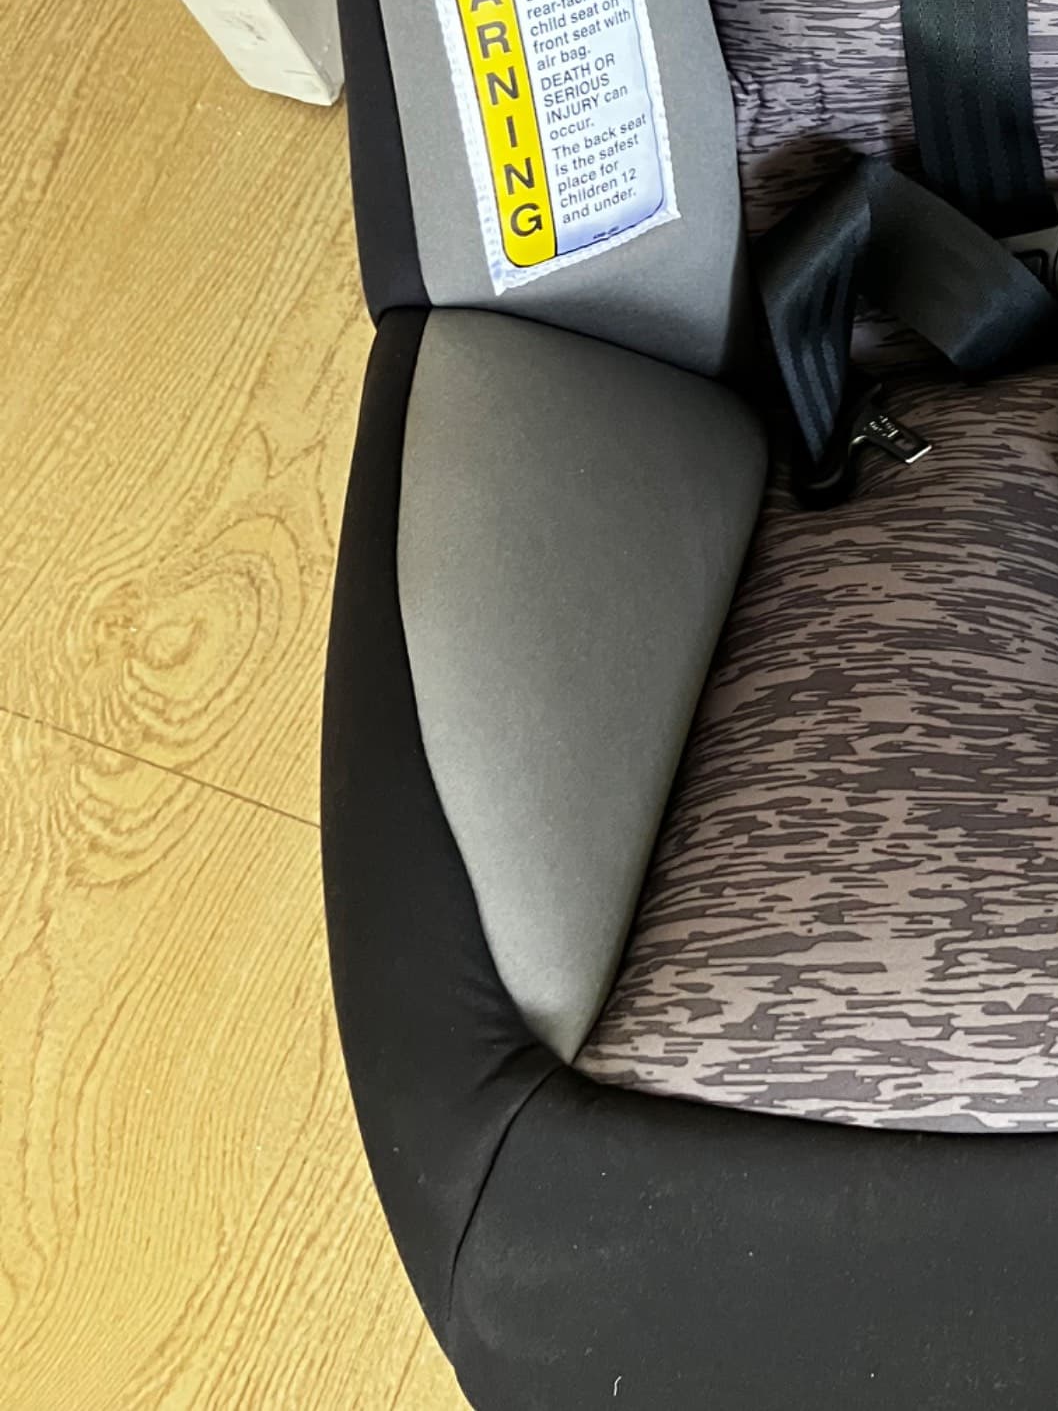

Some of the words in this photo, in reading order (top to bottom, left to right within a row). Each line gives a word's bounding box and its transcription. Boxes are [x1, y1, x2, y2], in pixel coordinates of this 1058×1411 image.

[530, 13, 567, 37] child
[570, 2, 599, 23] seat
[533, 31, 569, 54] front
[572, 20, 602, 41] seat
[604, 8, 631, 28] with
[537, 54, 556, 71] air
[560, 45, 591, 63] bag.
[541, 62, 591, 91] DEATH
[594, 53, 616, 71] OR
[543, 73, 610, 107] SERIOUS
[546, 93, 600, 125] INJURY
[604, 85, 628, 103] can
[549, 117, 595, 140] occur.
[552, 142, 581, 160] The
[584, 126, 616, 149] back
[619, 113, 646, 134] seat
[555, 163, 568, 176] is
[572, 154, 595, 170] the
[599, 133, 640, 160] safest
[557, 171, 597, 196] place
[600, 160, 620, 176] for
[560, 177, 618, 208] children
[621, 167, 637, 183] 12
[562, 203, 590, 224] and
[593, 186, 637, 212] under.
